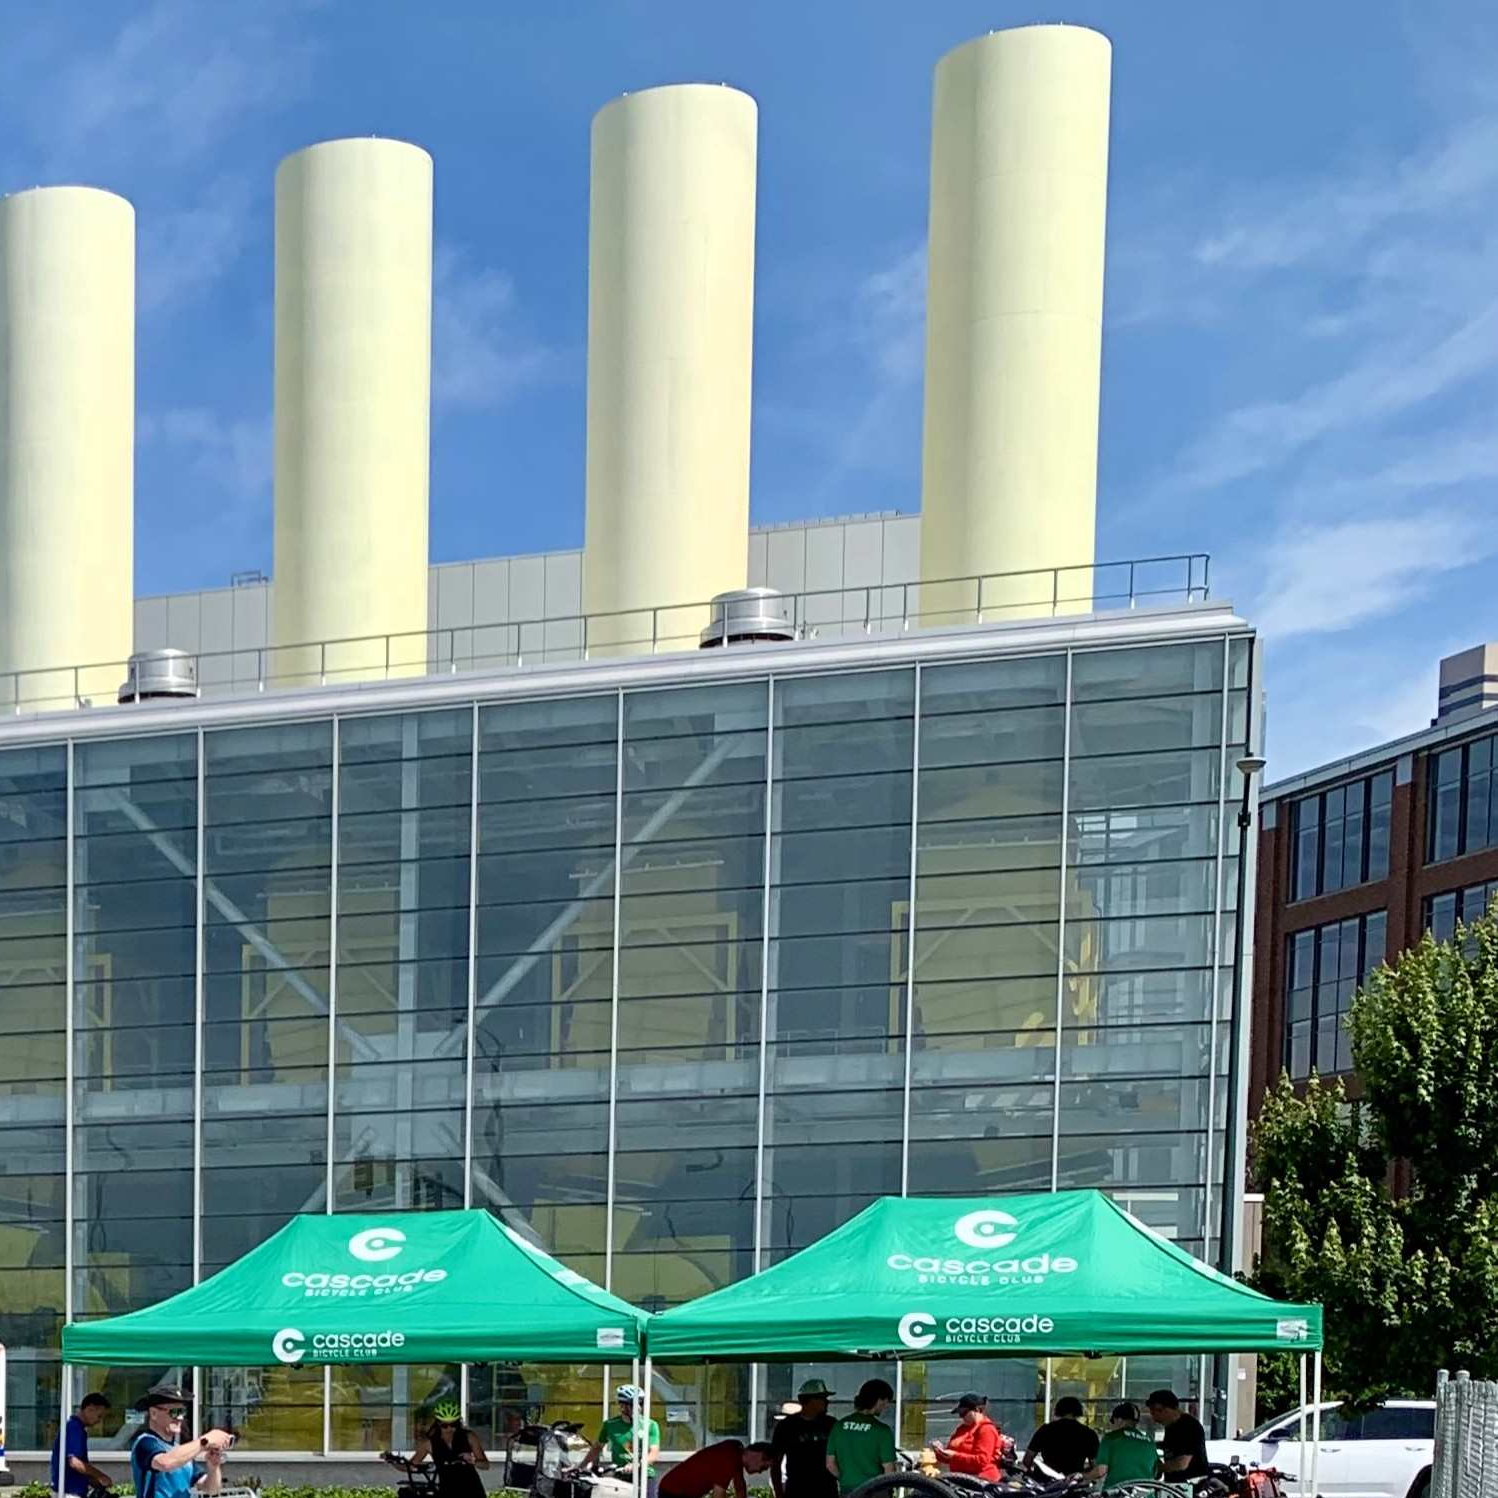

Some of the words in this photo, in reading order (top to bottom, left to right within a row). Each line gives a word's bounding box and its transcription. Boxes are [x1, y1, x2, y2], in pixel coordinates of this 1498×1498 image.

[887, 1253, 1079, 1275] cascade
[282, 1269, 448, 1288] cascade
[918, 1274, 991, 1286] BICYCLE
[999, 1275, 1045, 1285] CLUB
[305, 1288, 367, 1297] BICYCLE
[374, 1285, 414, 1295] CLUB
[945, 1314, 1054, 1333] cascade
[313, 1330, 405, 1348] cascade
[945, 1334, 990, 1343] BICYCLE
[993, 1334, 1021, 1343] CLUB
[313, 1349, 350, 1358] BICYCLE
[353, 1349, 378, 1357] CLUB
[843, 1421, 872, 1432] STAFF
